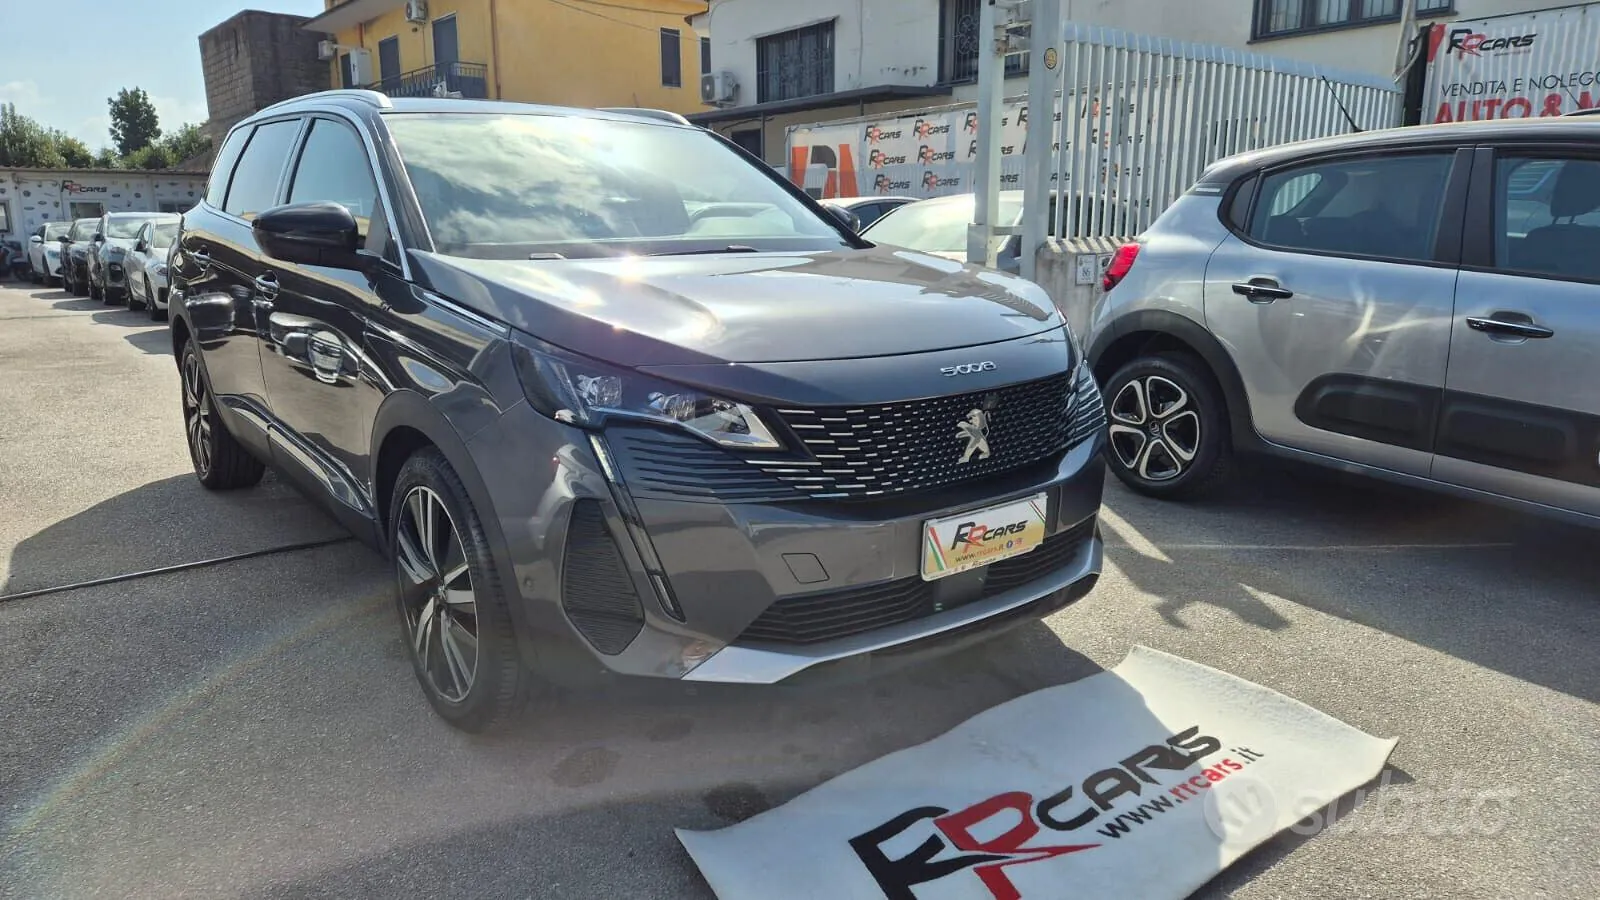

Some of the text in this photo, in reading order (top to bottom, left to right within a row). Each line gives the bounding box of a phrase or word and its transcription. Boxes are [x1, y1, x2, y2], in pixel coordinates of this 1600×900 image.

[1441, 80, 1507, 97] VENDITA
[1513, 79, 1523, 92] E
[1433, 97, 1532, 124] AUTO
[940, 361, 997, 377] 5008
[1096, 746, 1265, 839] www.rrcars.it
